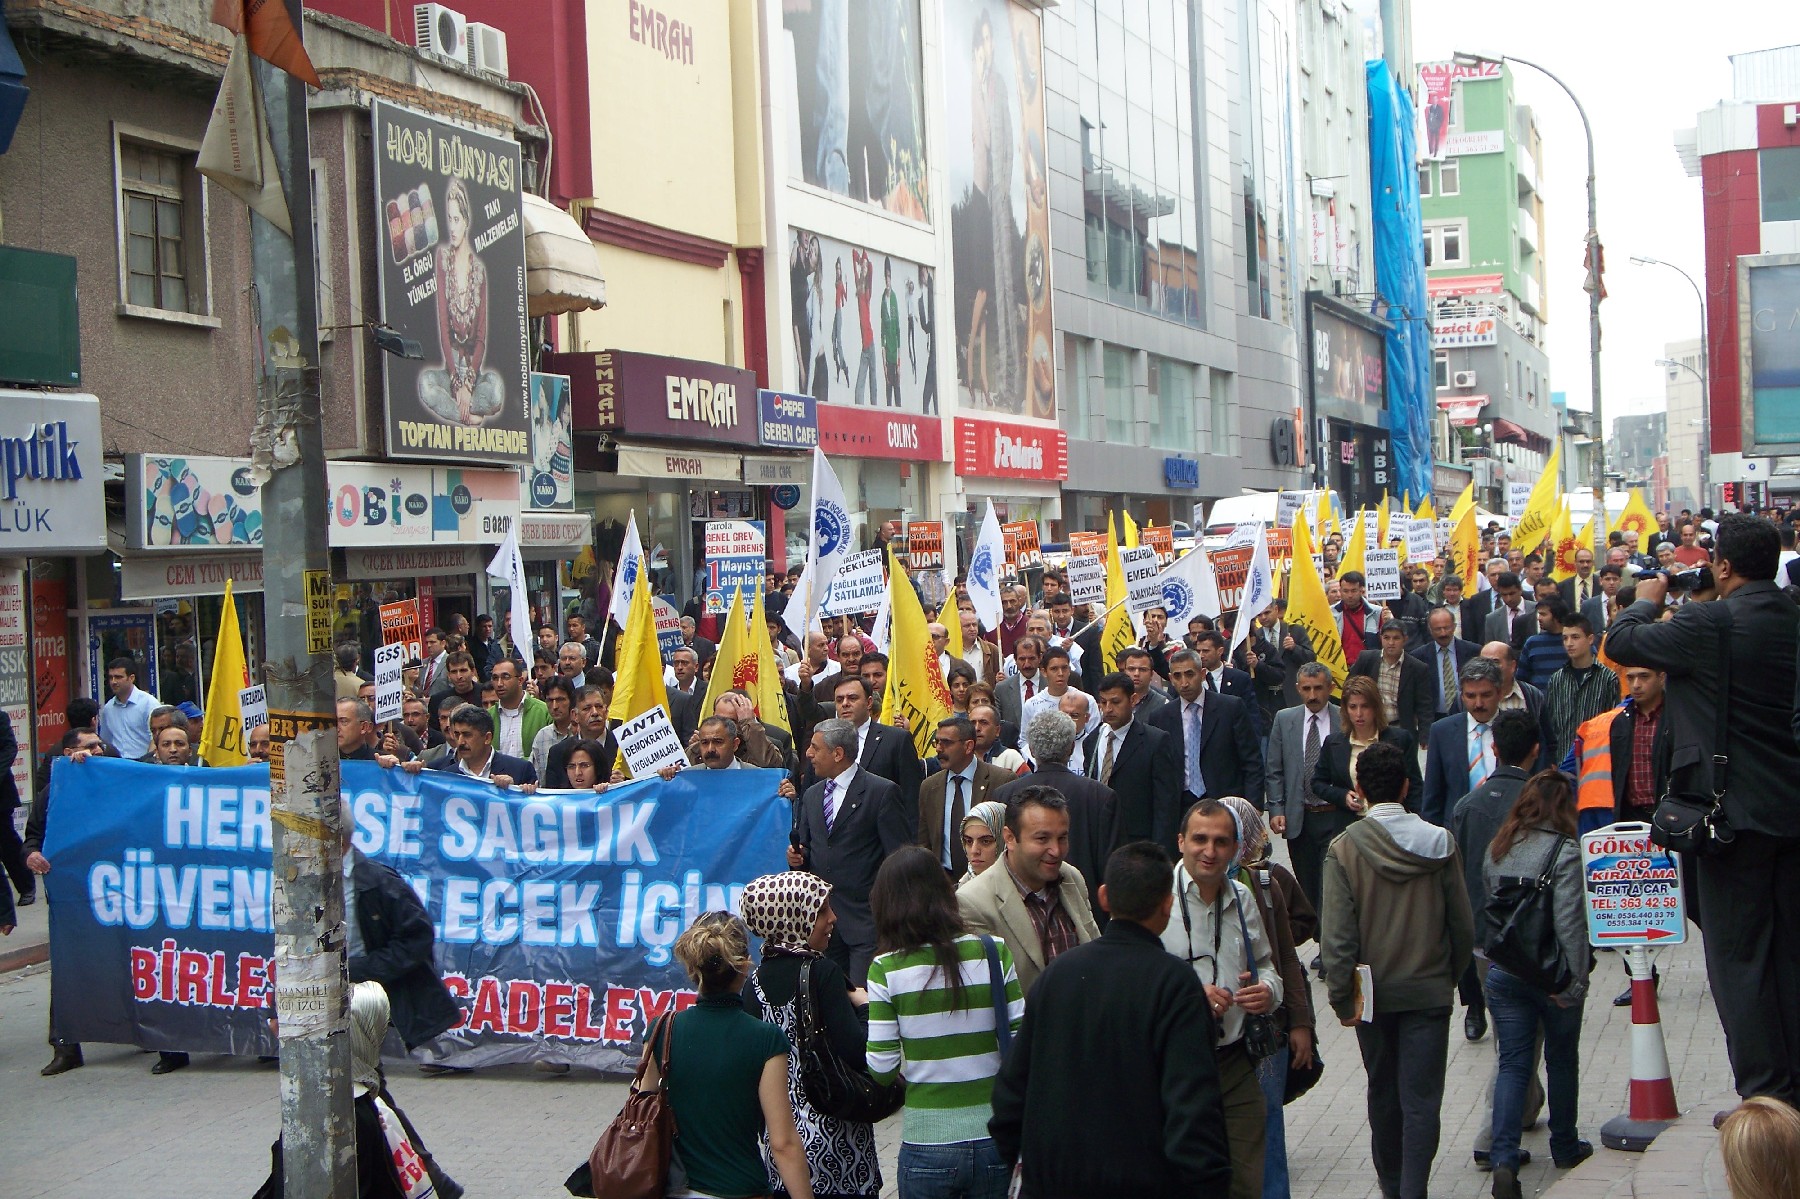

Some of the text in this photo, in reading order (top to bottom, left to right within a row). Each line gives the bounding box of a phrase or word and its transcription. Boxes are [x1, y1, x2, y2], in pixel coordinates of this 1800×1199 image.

[629, 0, 694, 66] EMRAH
[387, 121, 515, 193] HOBİ DÜNYASI
[484, 198, 501, 220] TAKI
[474, 209, 519, 253] MALZEMELERİ
[403, 250, 433, 285] EL ÖRGÜ
[407, 272, 438, 307] YÜNLERİ
[594, 352, 615, 426] EMRAH
[666, 375, 738, 430] EMRAH
[782, 400, 806, 419] PEPSI
[399, 420, 527, 455] TOPTAN PERAKENDE
[764, 421, 793, 443] SEREN
[794, 424, 818, 445] CAFE
[0, 420, 83, 501] ptik
[666, 456, 702, 475] EMRAH
[235, 477, 251, 486] NAK
[536, 485, 554, 495] NAKO
[408, 501, 424, 509] NAKO
[454, 495, 469, 504] NAKO
[521, 522, 561, 540] BEBE BEBE
[706, 521, 733, 531] Parola
[706, 532, 754, 543] GENEL GREV
[911, 540, 942, 551] HAKKI
[706, 544, 764, 556] GENEL DİRENİŞ
[1122, 547, 1155, 563] MEZARDA
[362, 550, 467, 573] ÇİÇEK MALZEMELERİ
[838, 555, 882, 577] ÇEKİLSİN
[910, 552, 942, 568] VAR
[166, 565, 197, 586] CEM
[199, 561, 225, 584] YÜN
[707, 559, 765, 591] 1 Mayıs'ta
[1127, 563, 1158, 583] EMEKLİ
[834, 574, 883, 592] SAĞLIK HAKTIR
[834, 583, 885, 602] SATILAMAZ
[1072, 584, 1102, 597] HAYIR
[1367, 581, 1399, 591] HAYIR
[382, 614, 414, 629] SAĞLIK
[383, 624, 420, 646] HAKKI
[0, 649, 26, 674] SSK
[376, 669, 401, 687] YASASINA
[241, 689, 265, 707] MEZARDA
[377, 691, 401, 709] HAYIR
[621, 707, 665, 741] ANTİ
[624, 725, 673, 758] DEMOKRATİK
[631, 742, 680, 773] UYGULAMALARA
[1617, 859, 1651, 870] OTO
[1591, 868, 1677, 881] KİRALAMA
[1596, 883, 1669, 896] RENT A CAR
[1591, 896, 1678, 909] TEL: 363 42 58
